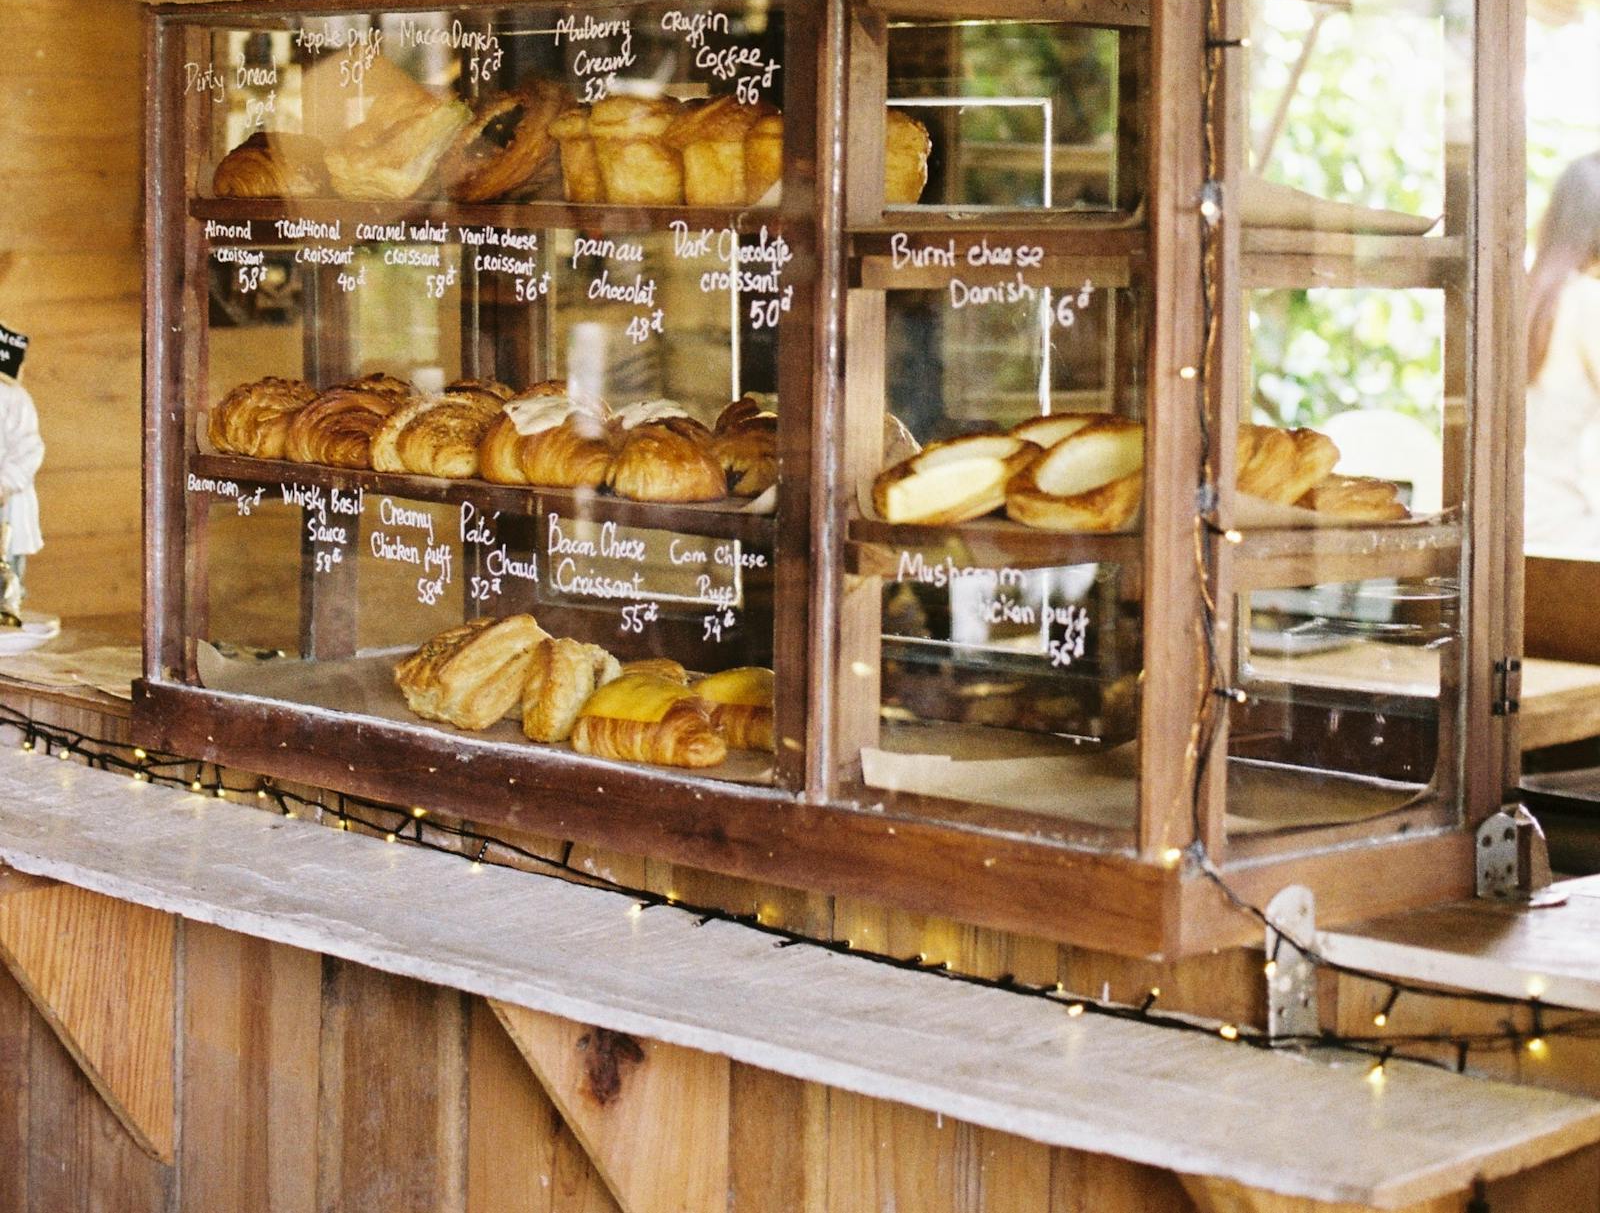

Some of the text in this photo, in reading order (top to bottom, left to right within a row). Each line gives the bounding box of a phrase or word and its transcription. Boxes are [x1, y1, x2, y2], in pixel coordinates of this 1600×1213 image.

[296, 22, 345, 54] Apple
[452, 19, 500, 52] Danish
[554, 14, 632, 57] Mulberry
[183, 52, 278, 103] Dirty Bread
[573, 49, 637, 77] Cream
[695, 45, 764, 81] Coffee
[204, 219, 252, 241] Almond
[459, 226, 499, 245] Vanilla
[615, 243, 644, 262] au
[890, 232, 956, 269] Burnt
[950, 271, 1035, 309] Danish
[331, 486, 365, 515] Basil
[307, 517, 348, 544] Sauce
[379, 497, 434, 546] Creamy
[547, 512, 646, 562] Bacon Cheese
[370, 531, 453, 584] Chicken puff
[486, 543, 540, 583] Chaud
[714, 544, 768, 569] Cheese
[556, 556, 645, 600] Croissant
